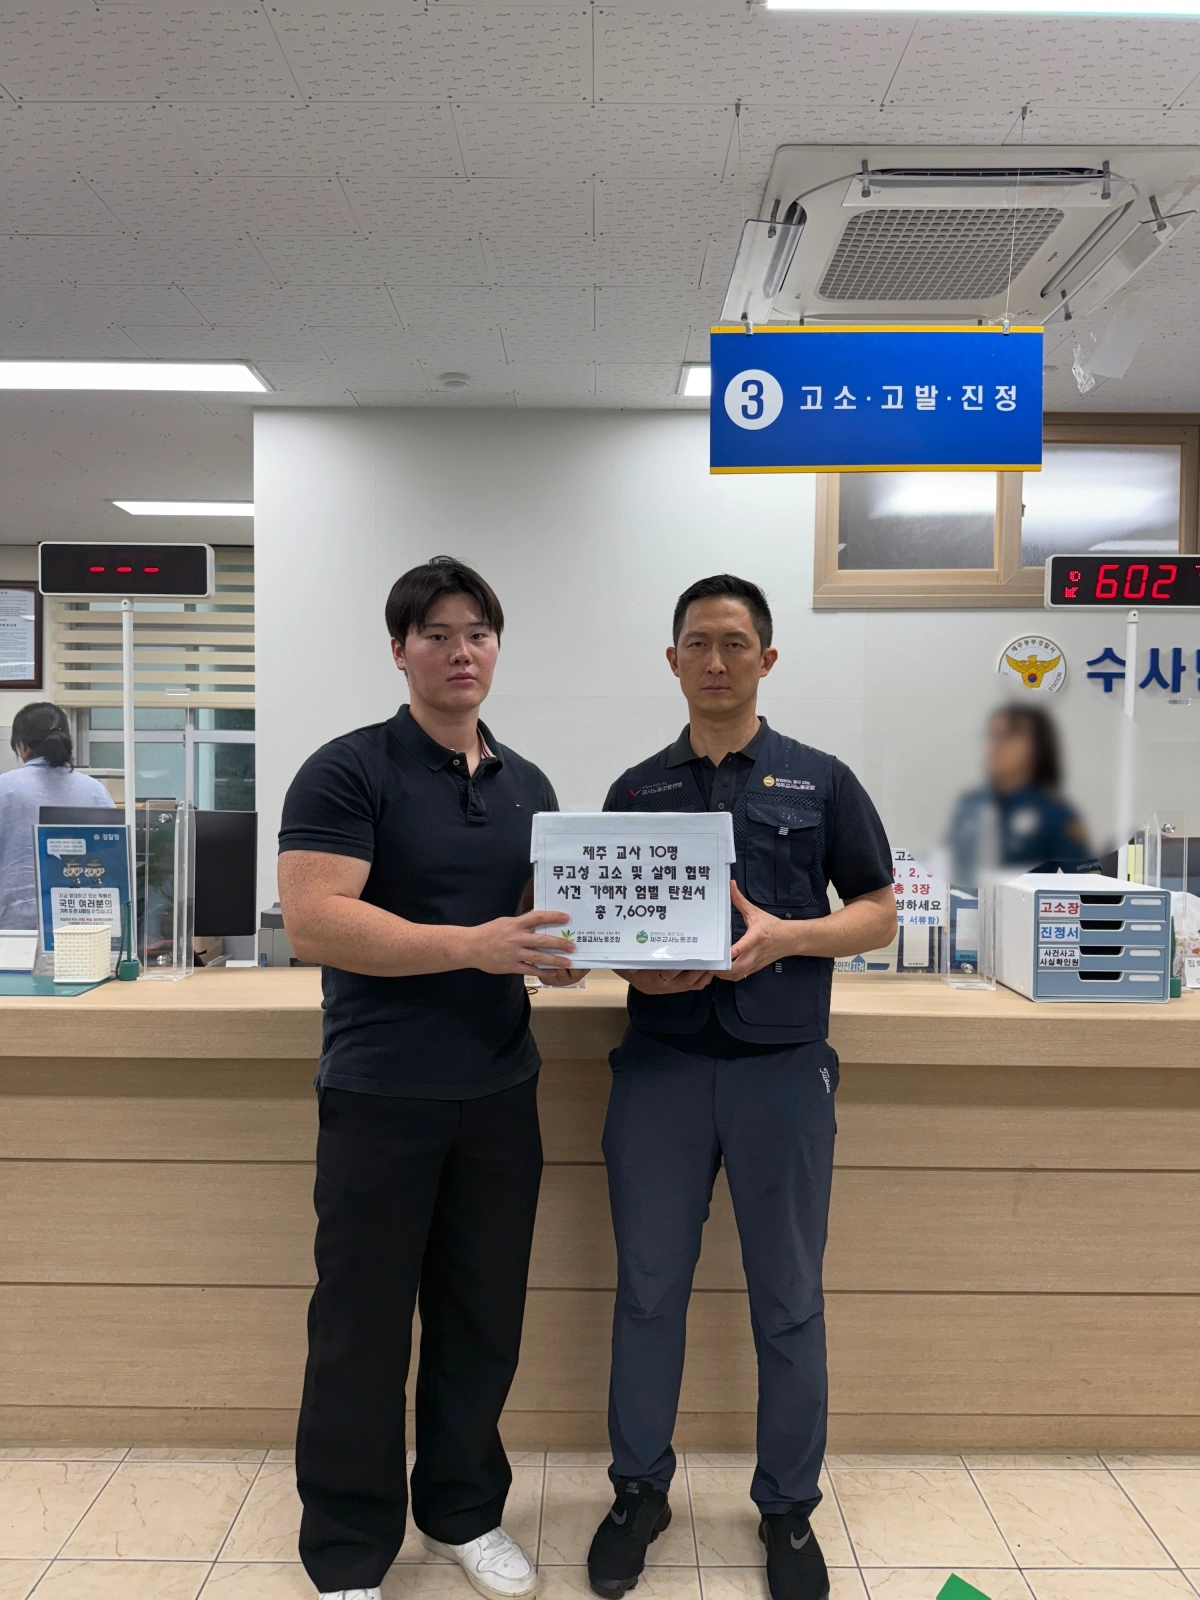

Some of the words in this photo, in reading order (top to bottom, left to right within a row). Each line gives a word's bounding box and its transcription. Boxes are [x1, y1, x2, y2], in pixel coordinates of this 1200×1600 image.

[741, 379, 764, 420] 3
[1095, 564, 1177, 599] 602
[102, 833, 120, 841] 경찰청
[583, 845, 607, 860] 제주
[616, 845, 641, 860] 교사
[649, 845, 678, 860] 10명
[553, 865, 590, 880] 무고성
[598, 866, 623, 880] 고소
[631, 865, 643, 880] 및
[651, 865, 677, 880] 살해
[685, 866, 711, 880] 협박
[557, 885, 581, 900] 사건
[590, 885, 627, 900] 가해자
[635, 885, 659, 900] 엄벌
[669, 885, 706, 900] 탄원서
[894, 883, 905, 895] 총
[912, 883, 931, 895] 3장
[59, 899, 76, 908] 국민
[79, 899, 112, 908] 여러분의
[1040, 902, 1080, 915] 고소장
[595, 905, 607, 920] 총
[615, 905, 667, 920] 7,609명
[909, 915, 940, 925] 서류함)
[1040, 926, 1079, 939] 진정서
[1044, 949, 1076, 957] 사건사고
[1040, 958, 1079, 967] 사실확인원
